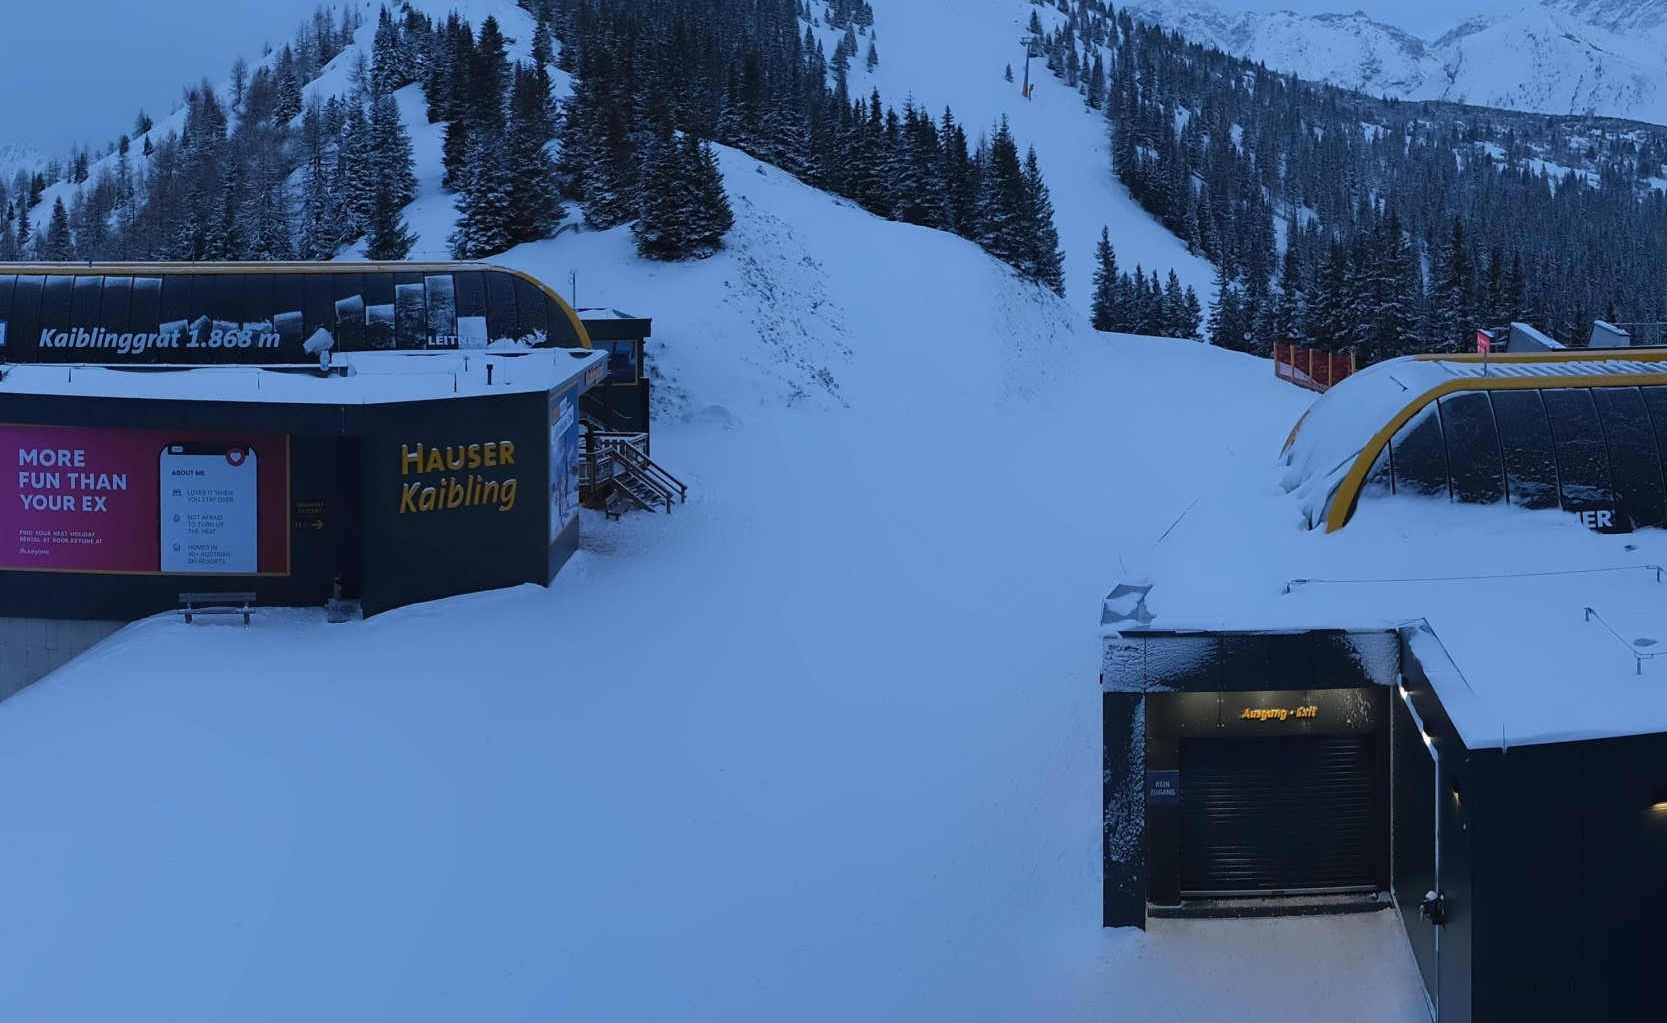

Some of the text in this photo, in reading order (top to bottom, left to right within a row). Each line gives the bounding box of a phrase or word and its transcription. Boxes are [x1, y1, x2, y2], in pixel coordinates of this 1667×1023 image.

[39, 327, 280, 354] Kaiblinggrat 1.868 m
[19, 448, 85, 467] MORE
[401, 440, 516, 475] HAUSER
[19, 471, 127, 490] FUN THAN
[20, 494, 107, 512] YOUR EX
[400, 475, 517, 513] Kaibling
[1241, 705, 1317, 721] Ausgang Exit
[1150, 788, 1175, 796] ZUGANG
